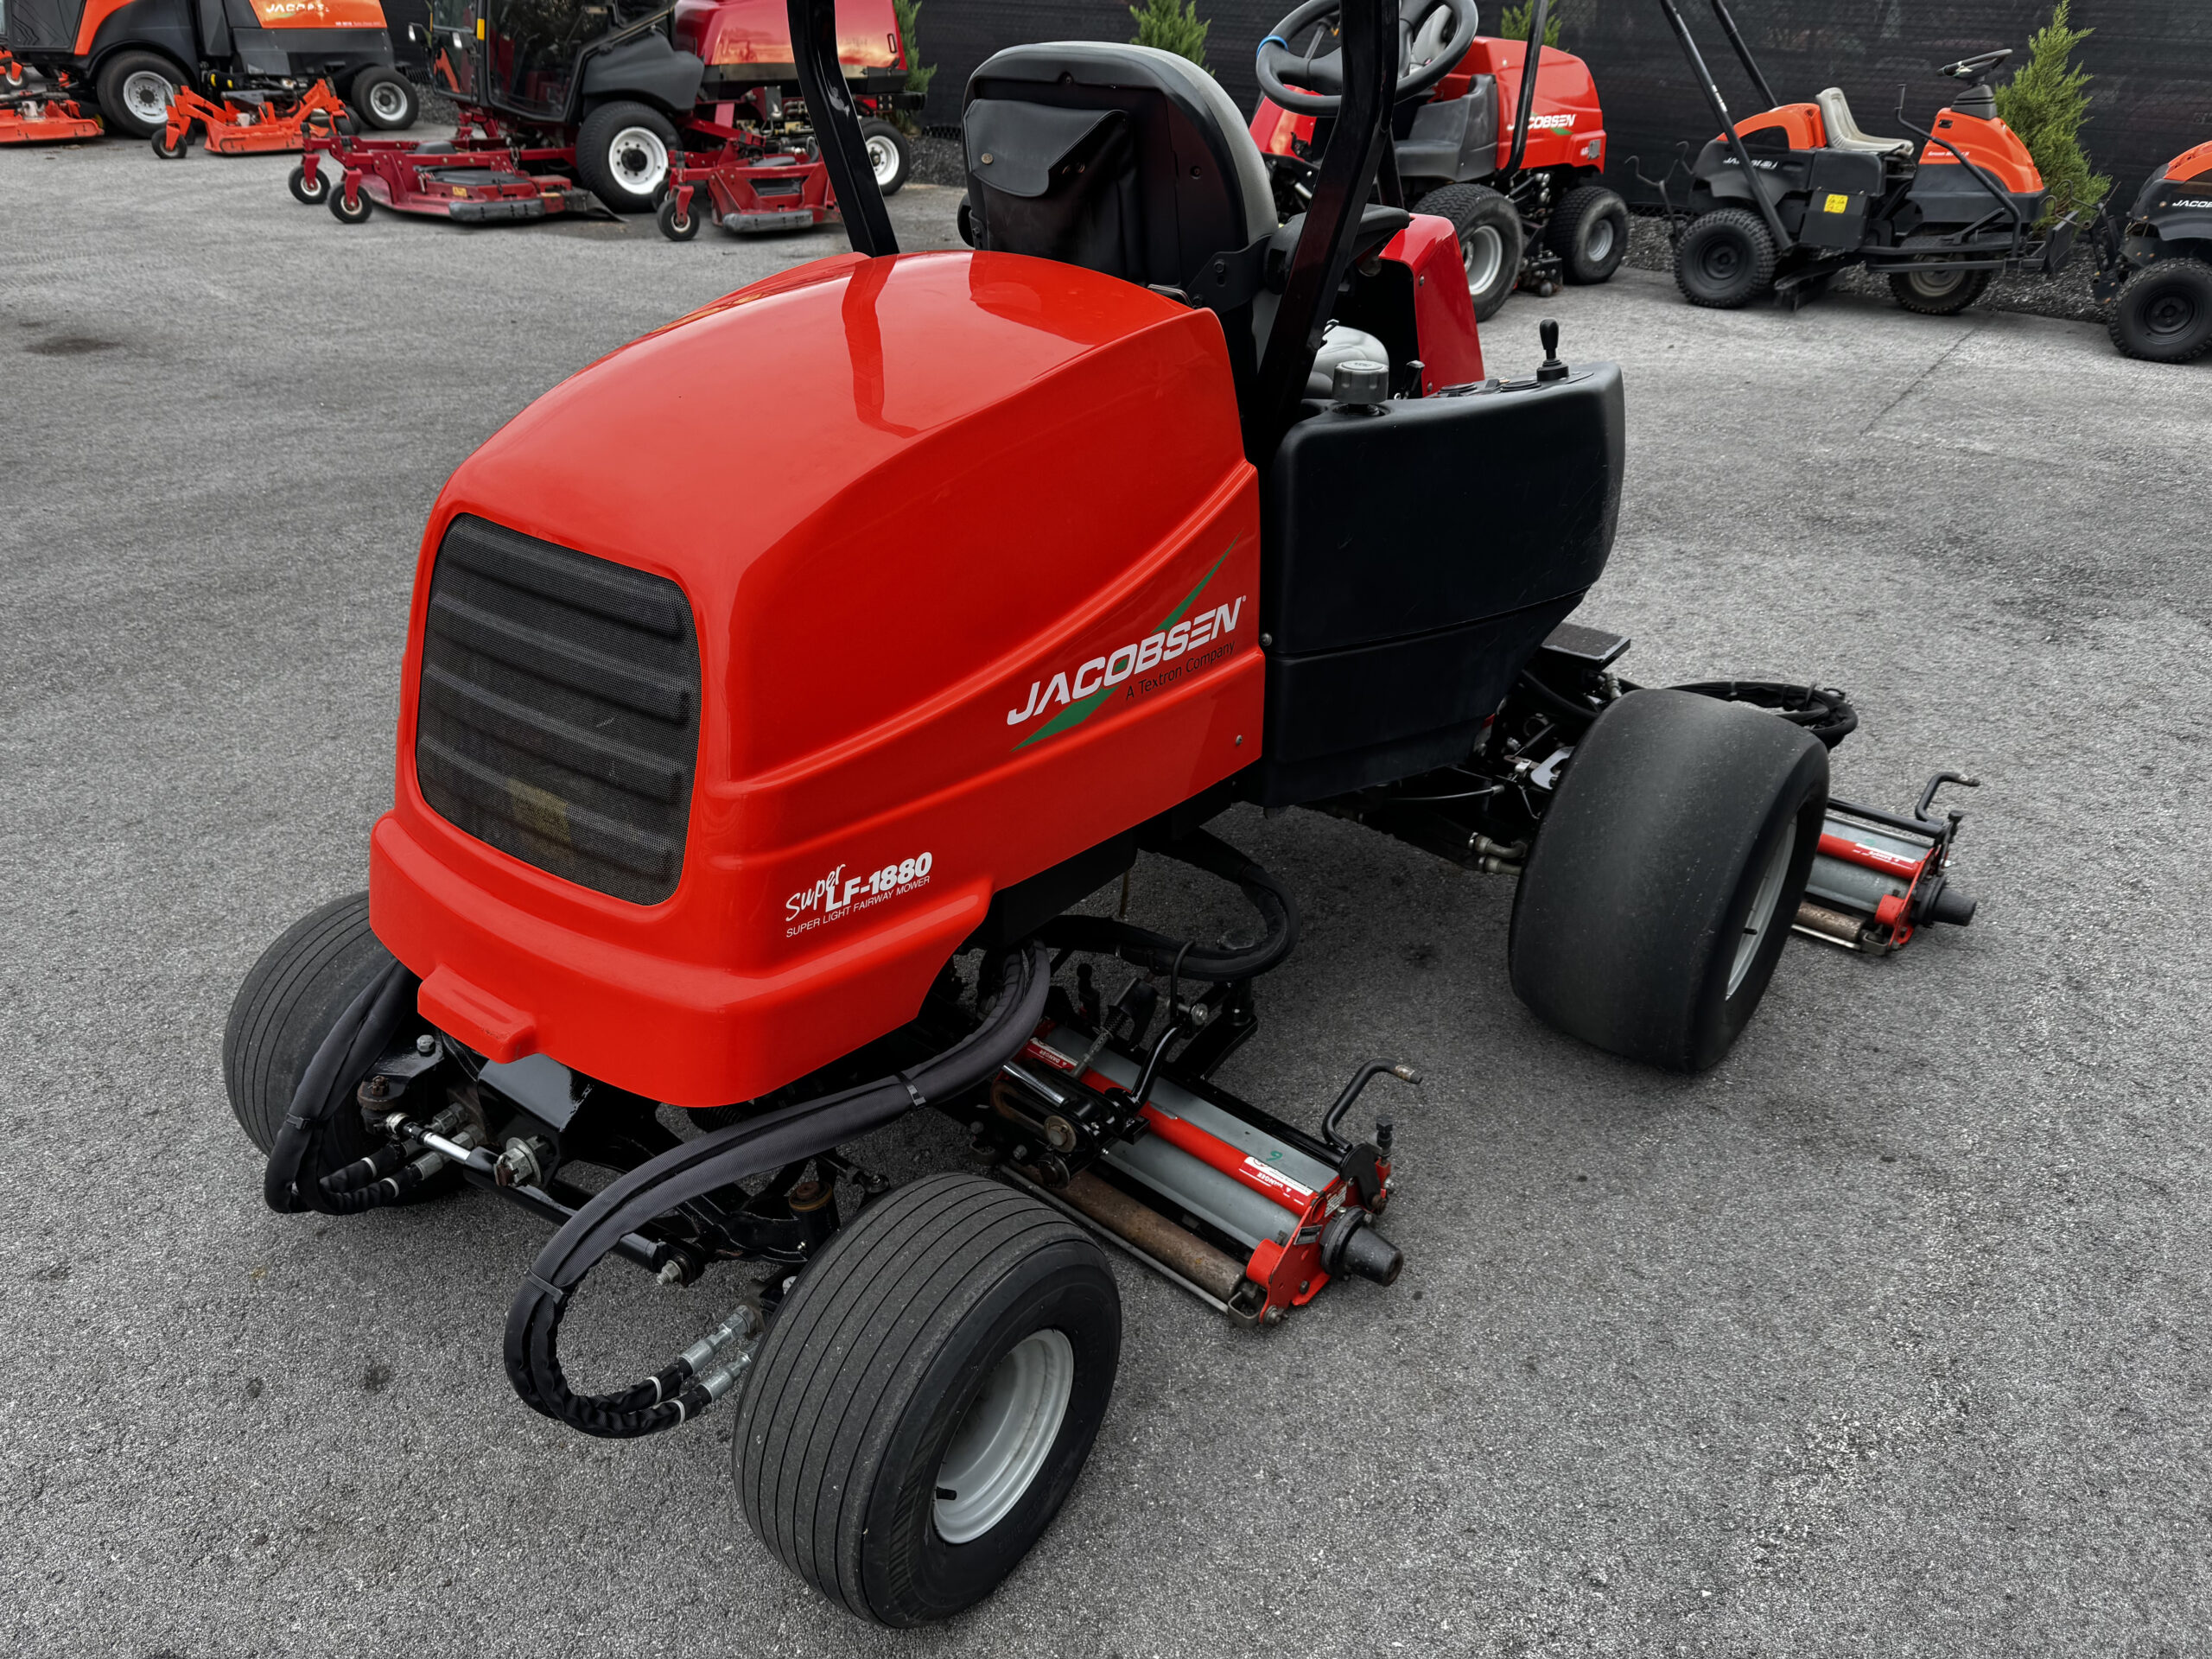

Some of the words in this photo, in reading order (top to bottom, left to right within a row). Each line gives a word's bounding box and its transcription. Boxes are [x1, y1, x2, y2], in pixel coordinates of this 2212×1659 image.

[1506, 114, 1577, 130] JCOBSEN
[1007, 595, 1243, 726] JACOBSEN
[1126, 685, 1135, 701] A
[1138, 666, 1183, 695] Textron
[1186, 640, 1236, 673] Company
[785, 864, 847, 922] Super
[786, 918, 821, 938] SUPER
[823, 906, 851, 925] LIGHT
[853, 889, 894, 912] FAIRWAY
[896, 875, 931, 897] MOWER
[825, 851, 933, 913] LF-1880
